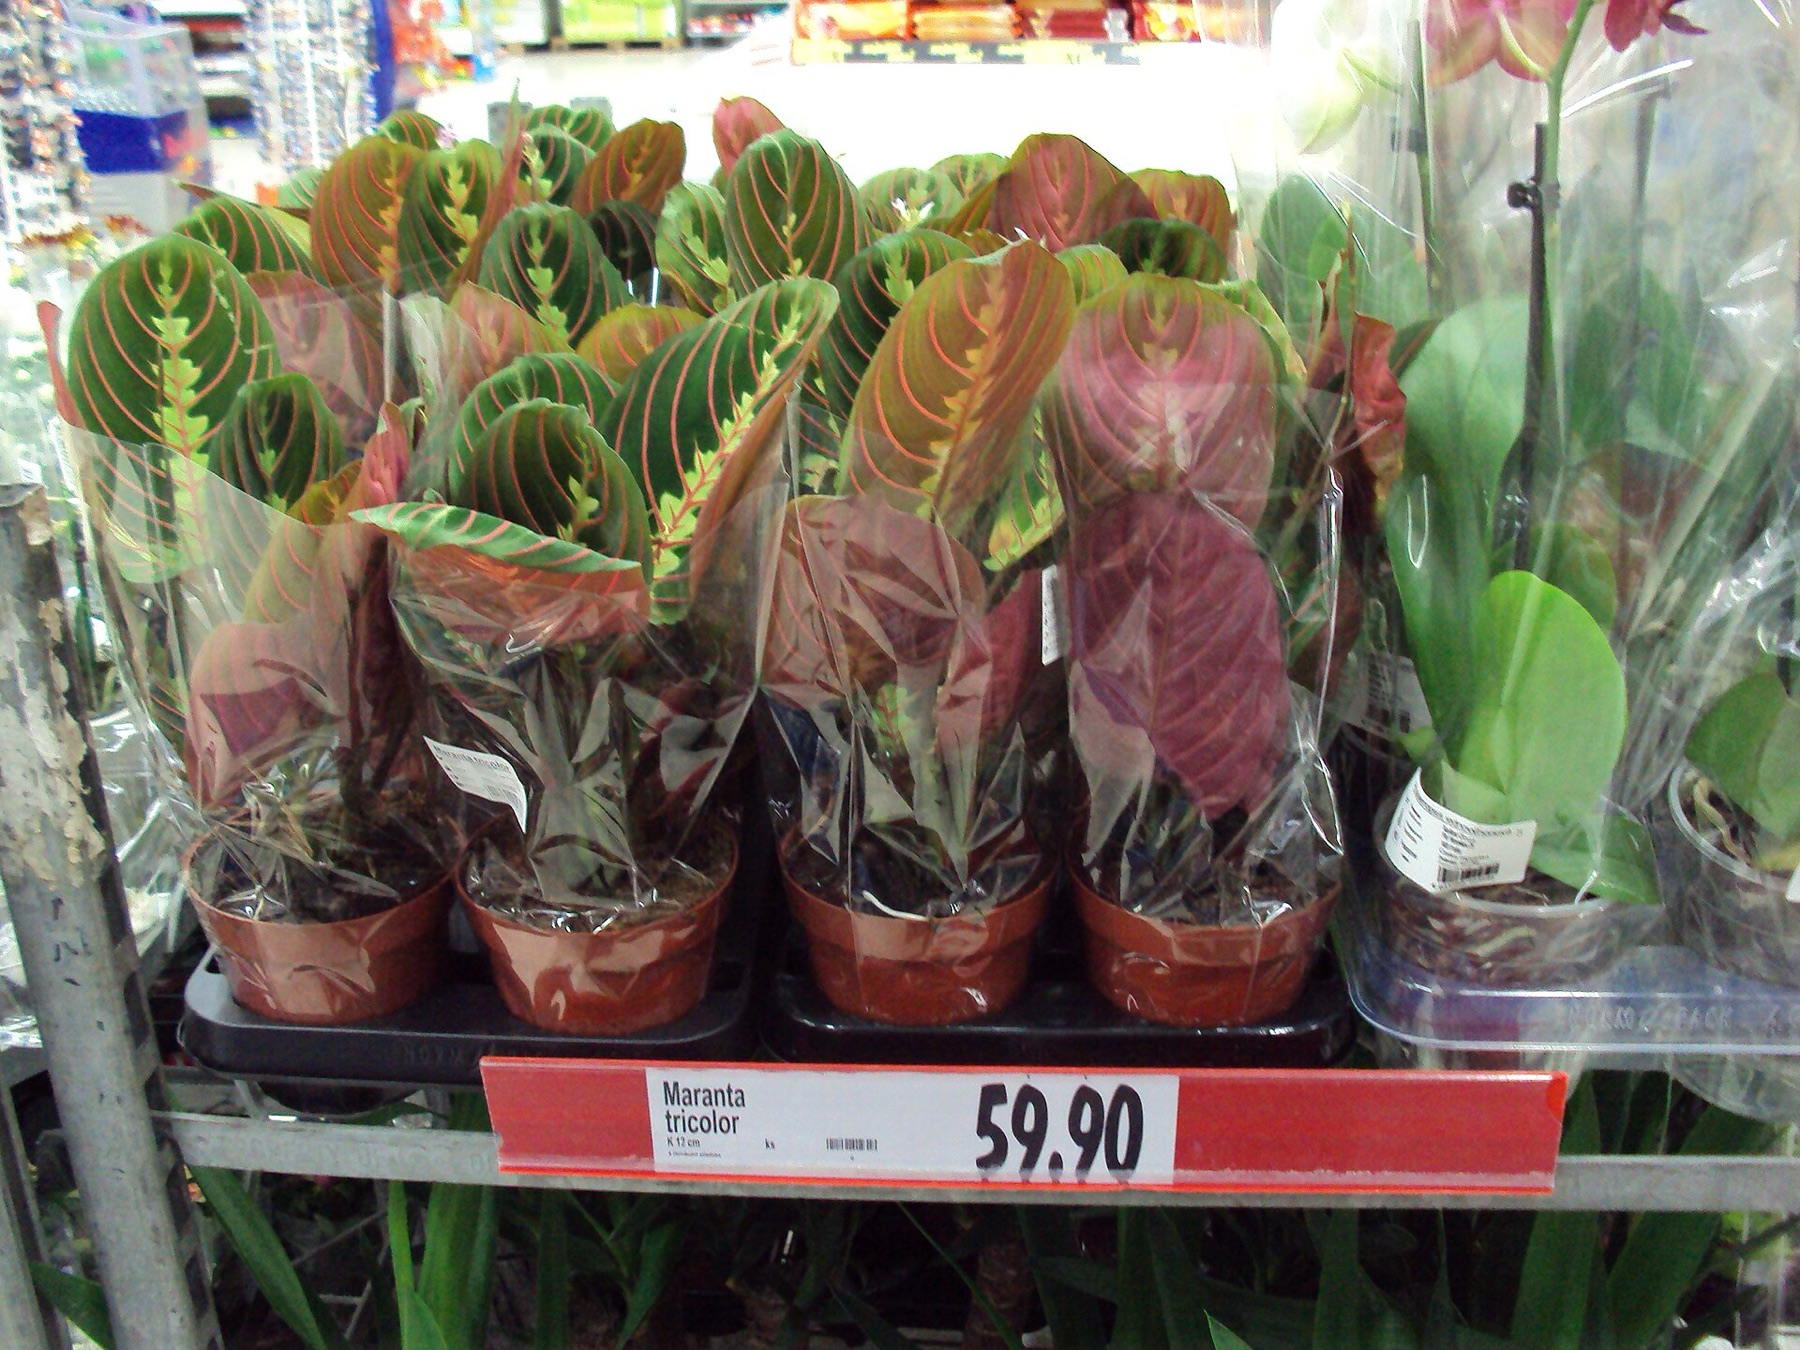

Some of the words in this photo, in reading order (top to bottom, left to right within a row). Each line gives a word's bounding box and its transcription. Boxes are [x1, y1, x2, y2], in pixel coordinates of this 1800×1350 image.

[663, 1081, 746, 1107] Maranta
[665, 1109, 740, 1134] tricolor
[976, 1083, 1143, 1181] 59.90
[667, 1136, 674, 1148] K
[676, 1137, 686, 1148] 12
[687, 1138, 701, 1148] cm
[764, 1138, 776, 1149] ks
